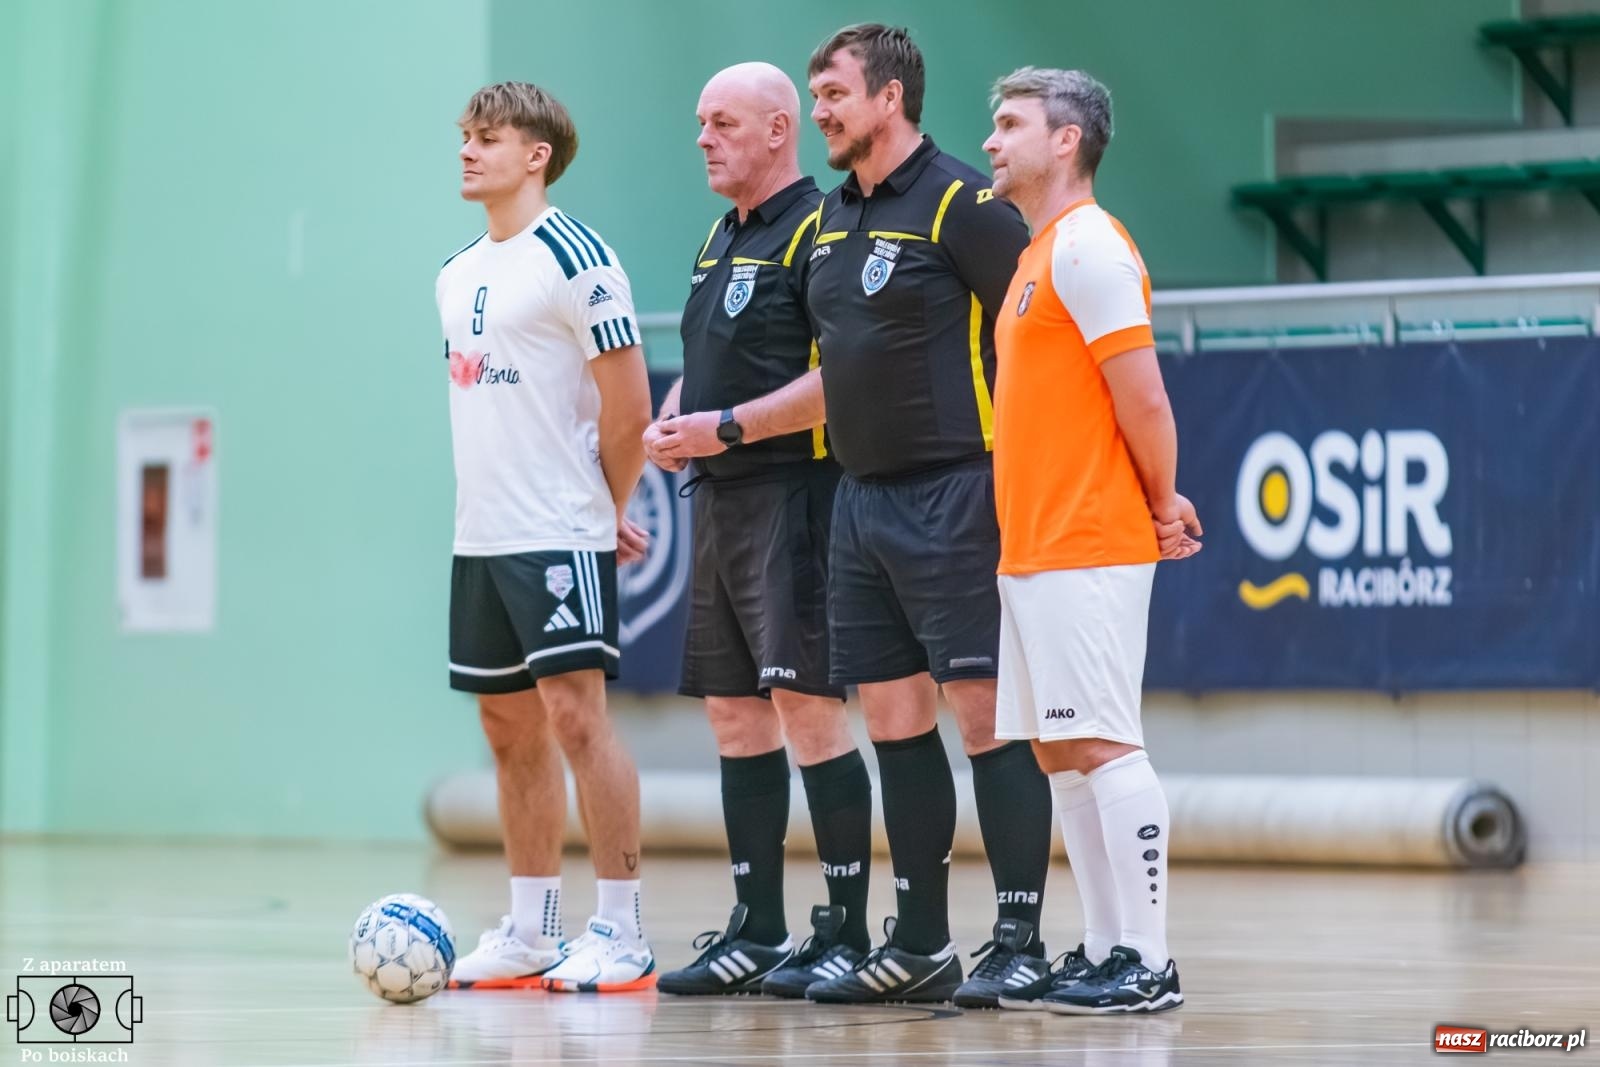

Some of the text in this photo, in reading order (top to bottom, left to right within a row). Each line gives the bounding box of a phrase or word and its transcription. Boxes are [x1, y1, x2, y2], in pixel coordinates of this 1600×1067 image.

[588, 294, 613, 307] adidas
[473, 286, 488, 335] 9
[1318, 557, 1453, 607] RACIBÓRZ
[1045, 708, 1076, 719] JAKO
[998, 890, 1039, 904] zina
